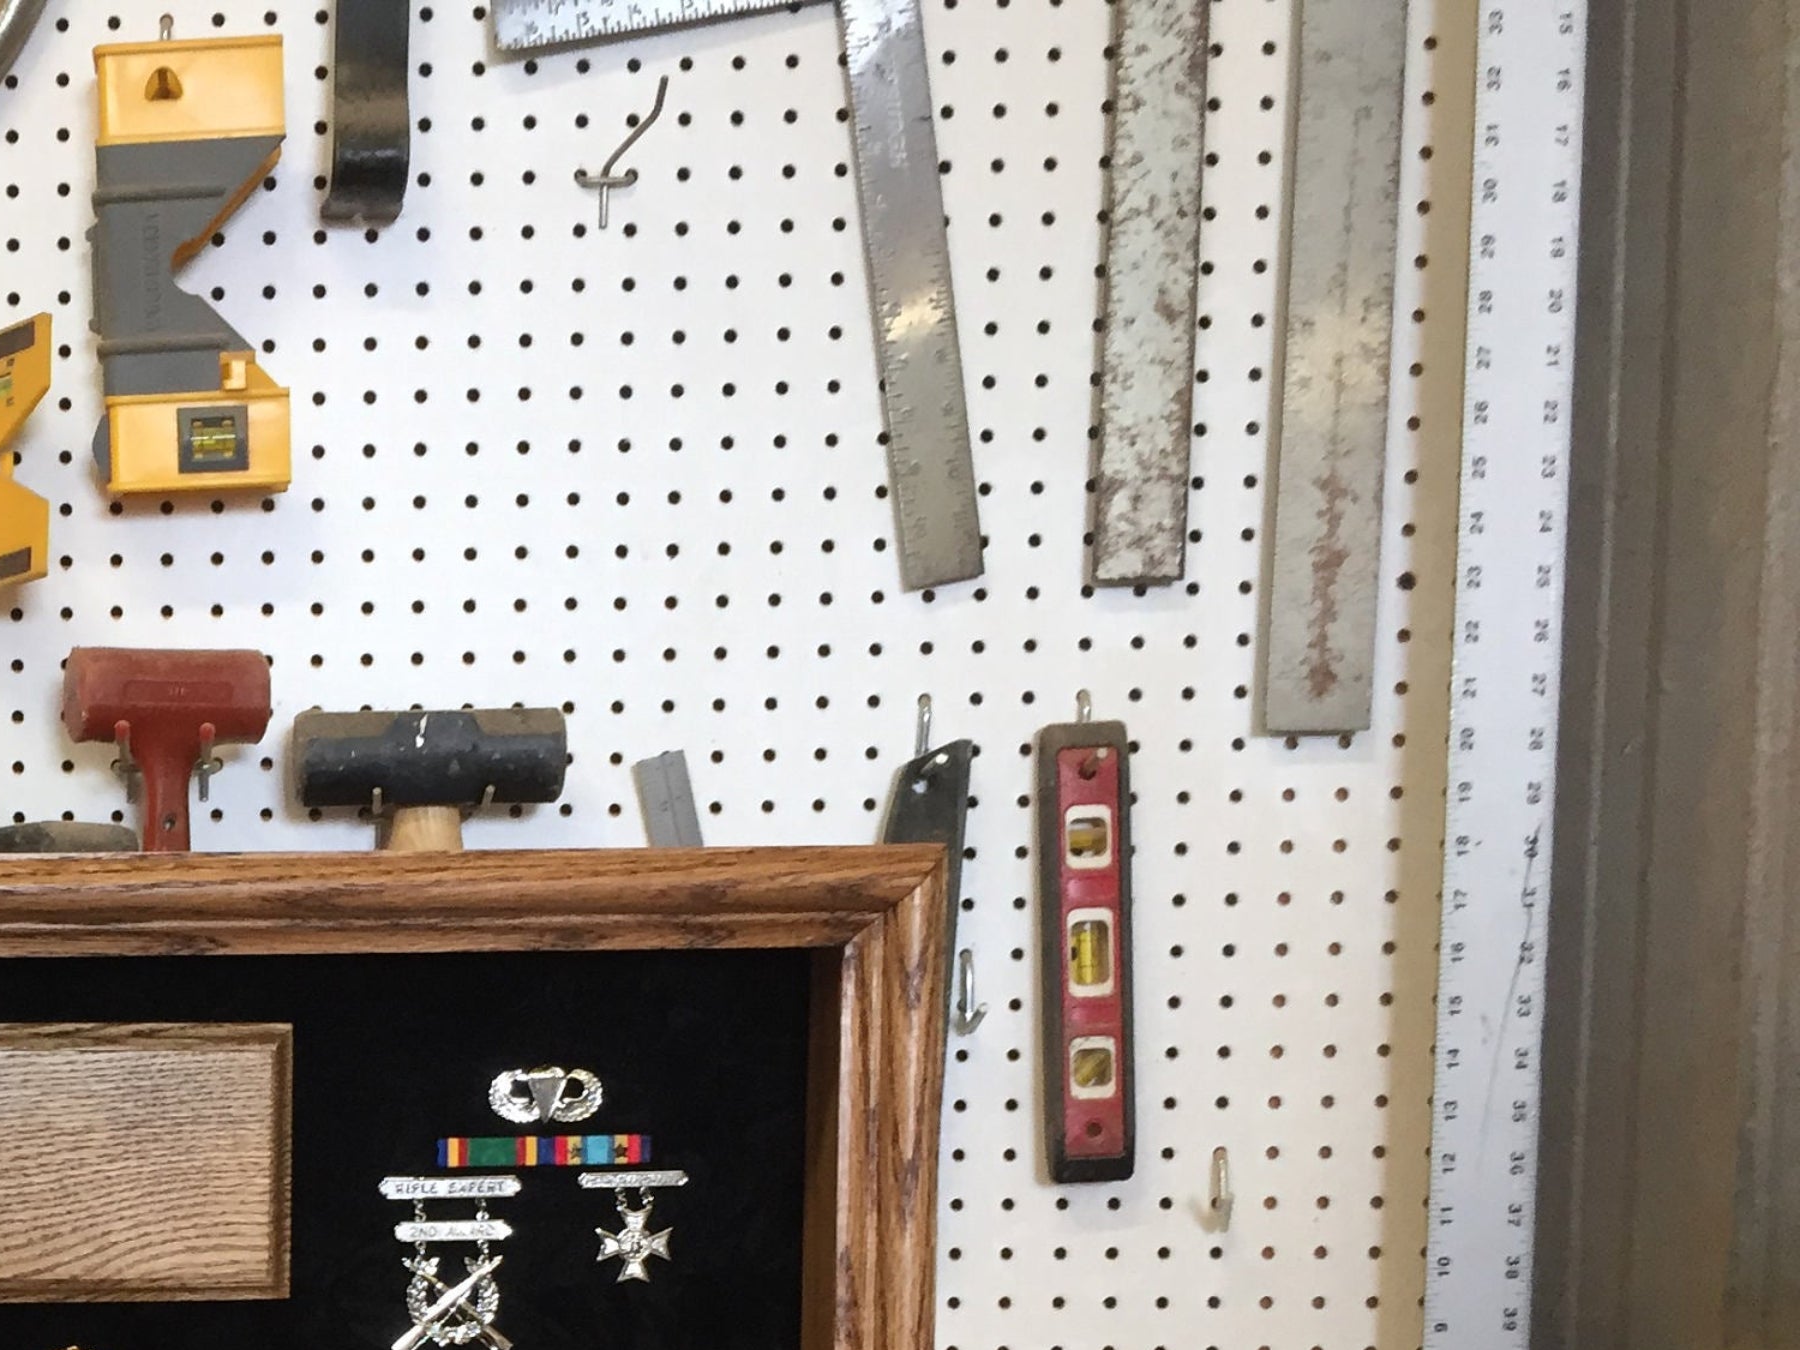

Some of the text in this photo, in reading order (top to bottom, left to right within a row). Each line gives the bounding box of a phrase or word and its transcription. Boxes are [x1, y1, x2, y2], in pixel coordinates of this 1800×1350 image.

[1488, 8, 1504, 36] 33
[1486, 65, 1502, 92] 32
[1484, 123, 1500, 148] 31
[1482, 177, 1498, 204] 30
[1480, 233, 1496, 260] 29
[1478, 288, 1493, 315] 28
[1476, 344, 1491, 371] 27
[1473, 399, 1489, 426] 26
[1471, 454, 1487, 481] 25
[1469, 509, 1485, 536] 24
[1466, 564, 1483, 590] 23
[1464, 619, 1480, 645] 22
[1461, 674, 1477, 700] 21
[1459, 726, 1475, 752] 20
[1457, 780, 1473, 804] 19
[1455, 834, 1470, 858] 18
[1453, 888, 1468, 912] 17
[1450, 940, 1466, 964] 16
[1448, 994, 1463, 1018] 15
[1446, 1047, 1461, 1071] 14
[1443, 1099, 1458, 1123] 13
[1441, 1152, 1456, 1175] 12
[394, 1180, 506, 1195] RIFLE EXPERT
[1439, 1204, 1454, 1227] 11
[1436, 1255, 1452, 1278] 10
